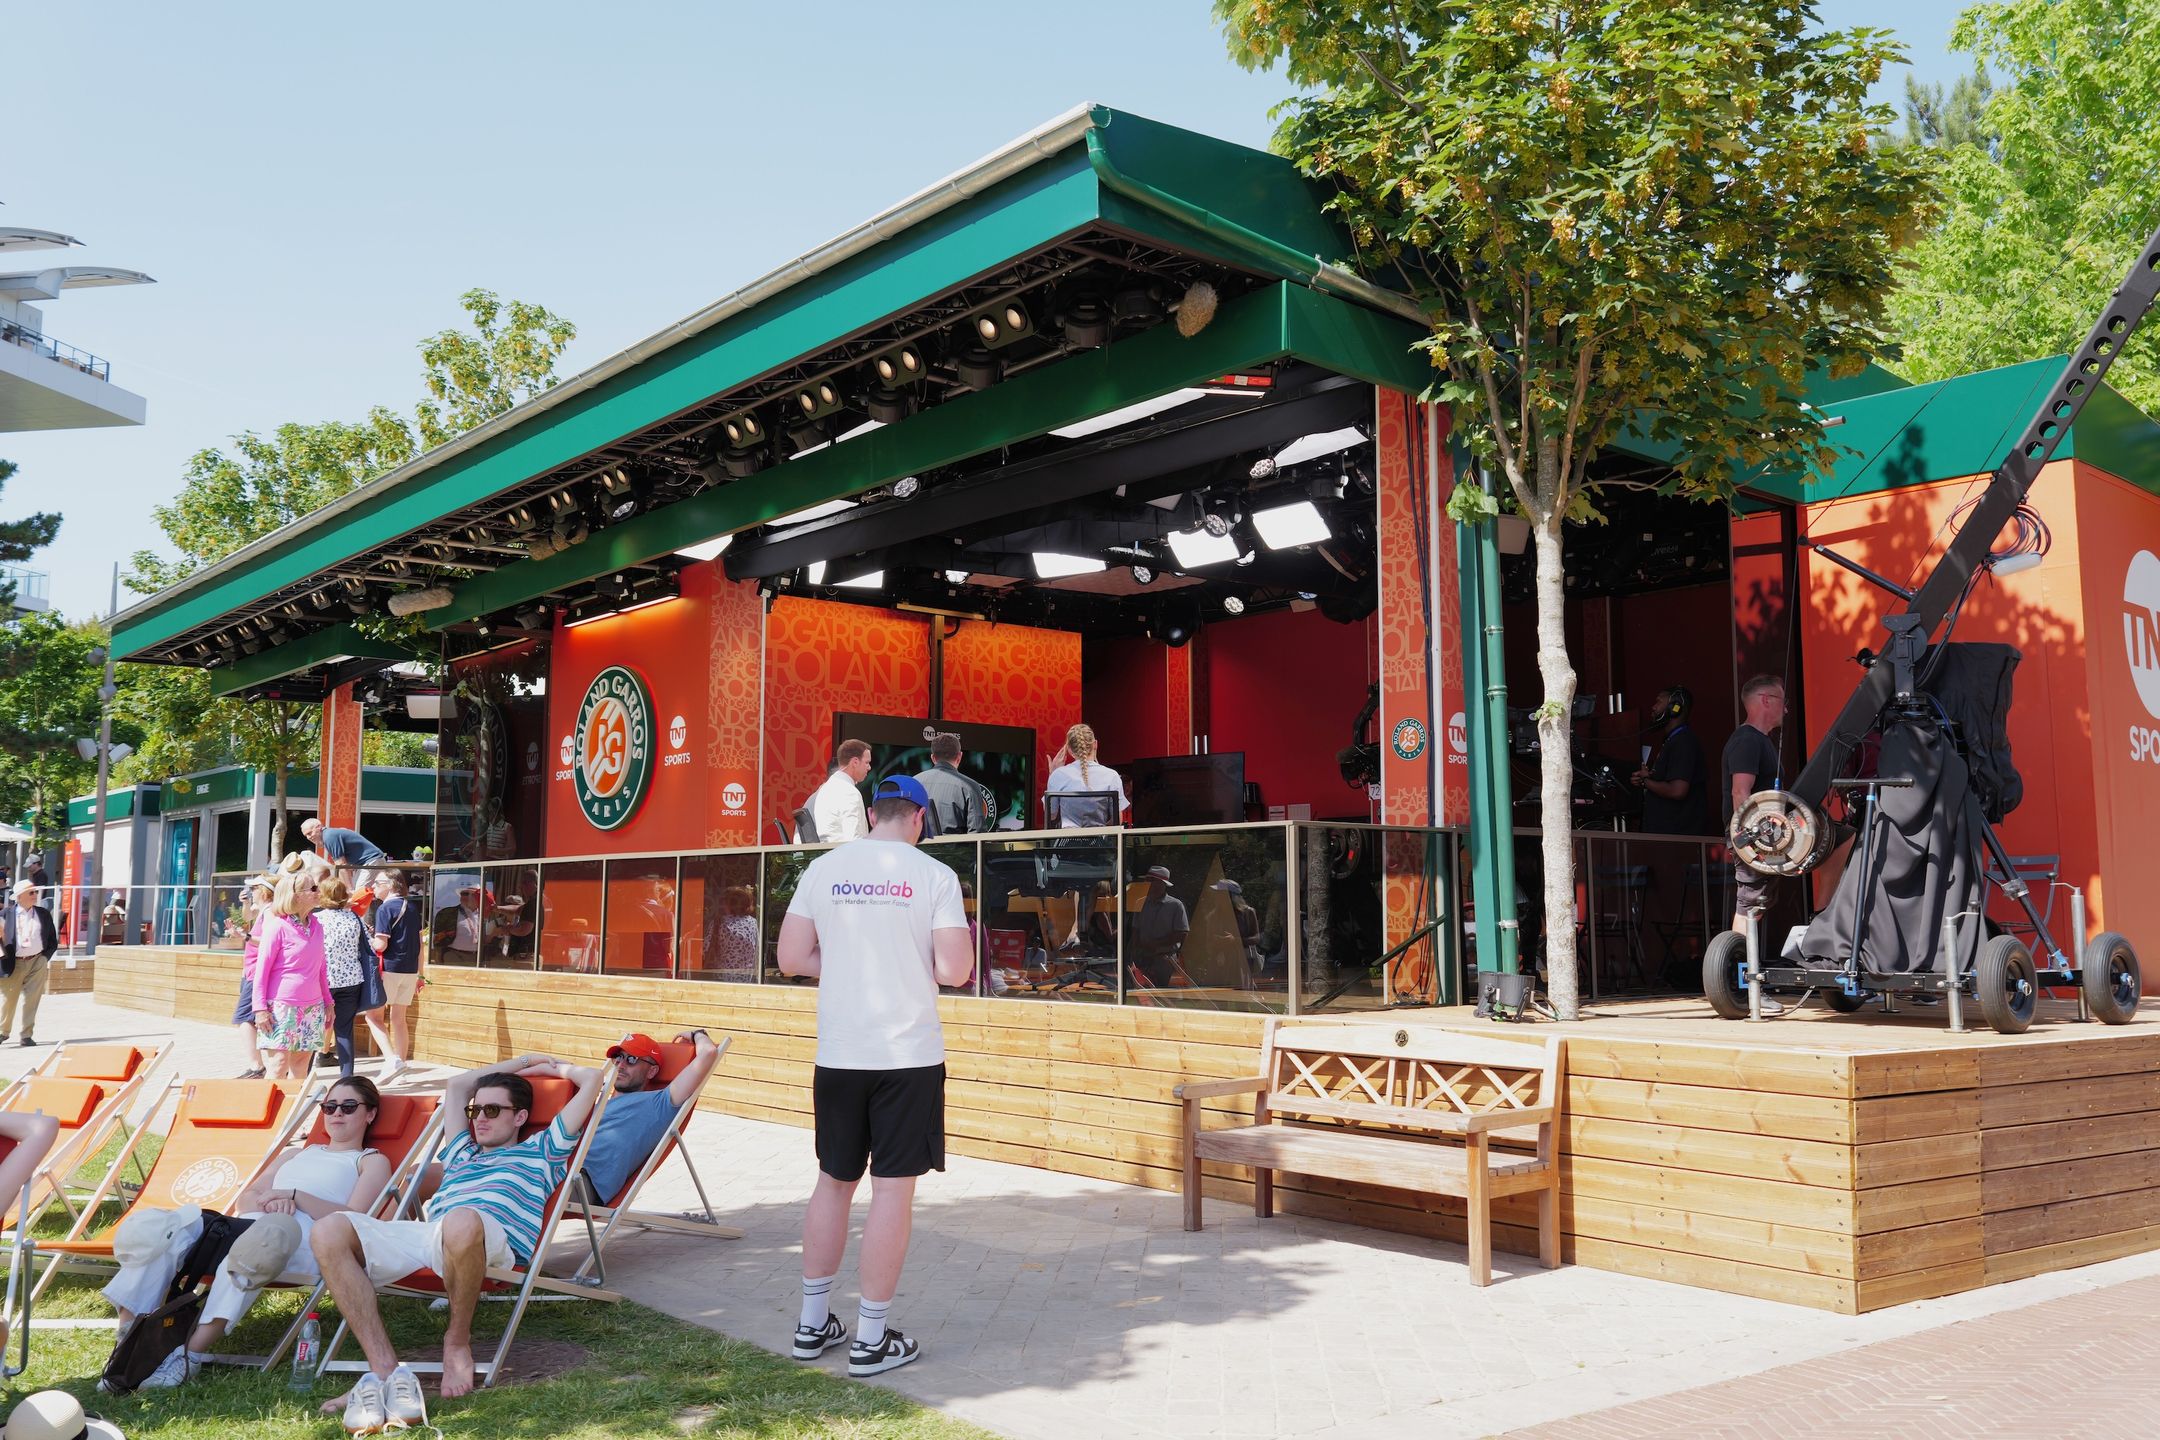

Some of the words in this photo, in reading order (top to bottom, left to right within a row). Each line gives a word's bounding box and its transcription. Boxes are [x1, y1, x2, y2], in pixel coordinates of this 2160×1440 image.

[2122, 601, 2160, 671] TN
[575, 678, 609, 770] ROLAND
[612, 675, 644, 760] GARROS
[669, 727, 686, 741] TNT
[1393, 720, 1409, 745] ROLAND
[1409, 720, 1425, 743] GARROS
[1448, 726, 1466, 742] TN
[2129, 725, 2160, 765] SPO
[664, 752, 691, 767] SPORTS
[1448, 754, 1468, 765] SPOR
[556, 768, 574, 782] SPORT
[722, 792, 746, 802] TNT
[1371, 786, 1381, 796] 72
[585, 785, 631, 818] PARIS
[981, 789, 995, 818] ARROS
[721, 809, 747, 817] SPORTS
